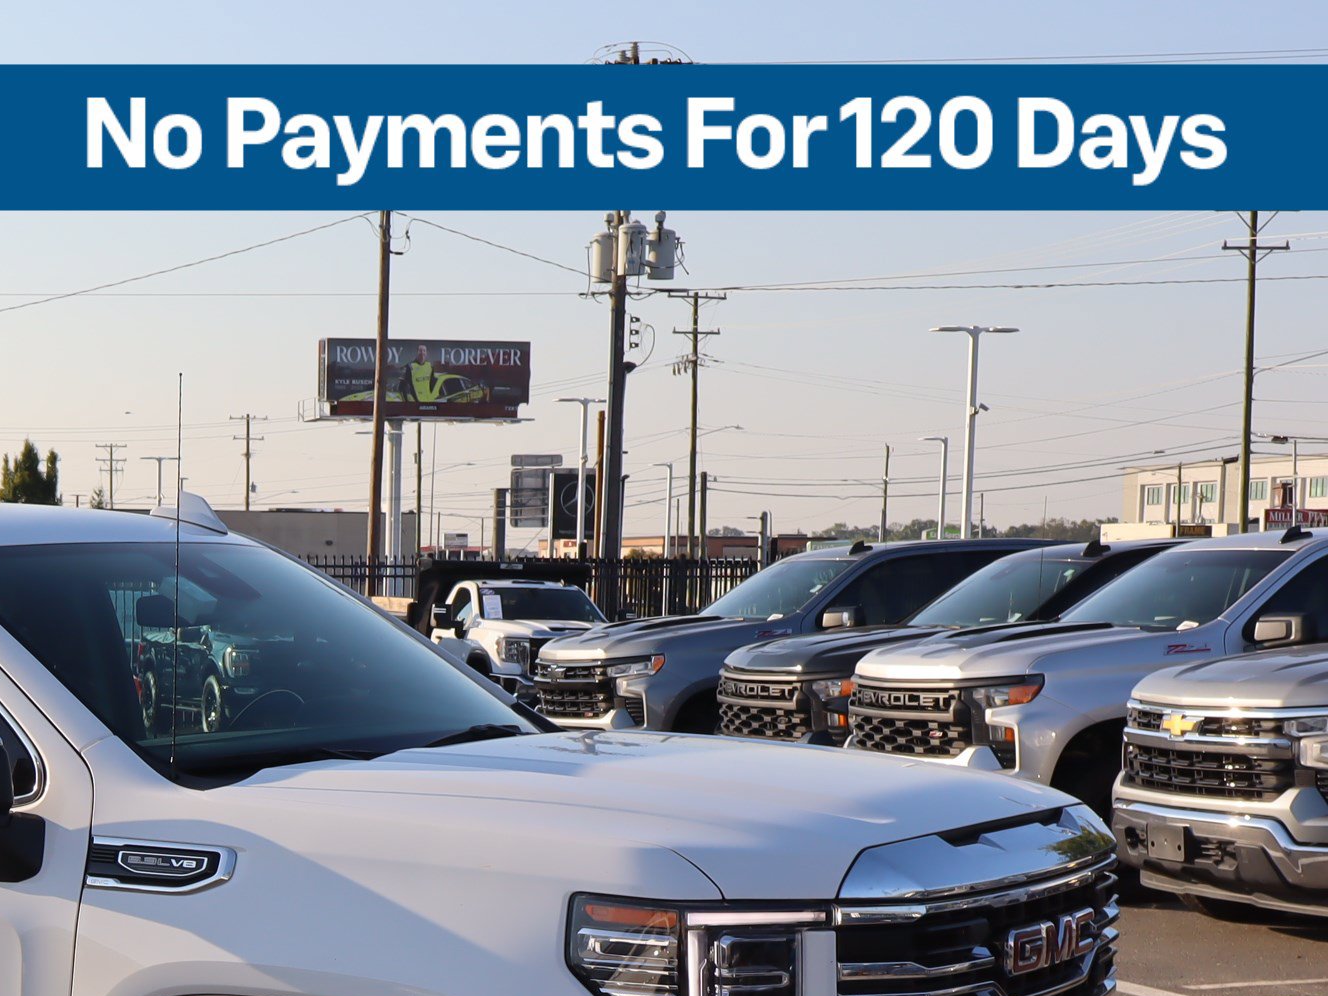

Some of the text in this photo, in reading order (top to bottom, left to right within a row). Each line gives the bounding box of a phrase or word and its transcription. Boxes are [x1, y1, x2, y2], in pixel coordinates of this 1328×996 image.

[440, 348, 522, 366] FOREVER
[1269, 511, 1303, 522] MILLR
[851, 687, 949, 709] CHEVROLET
[1004, 907, 1094, 976] GMC
